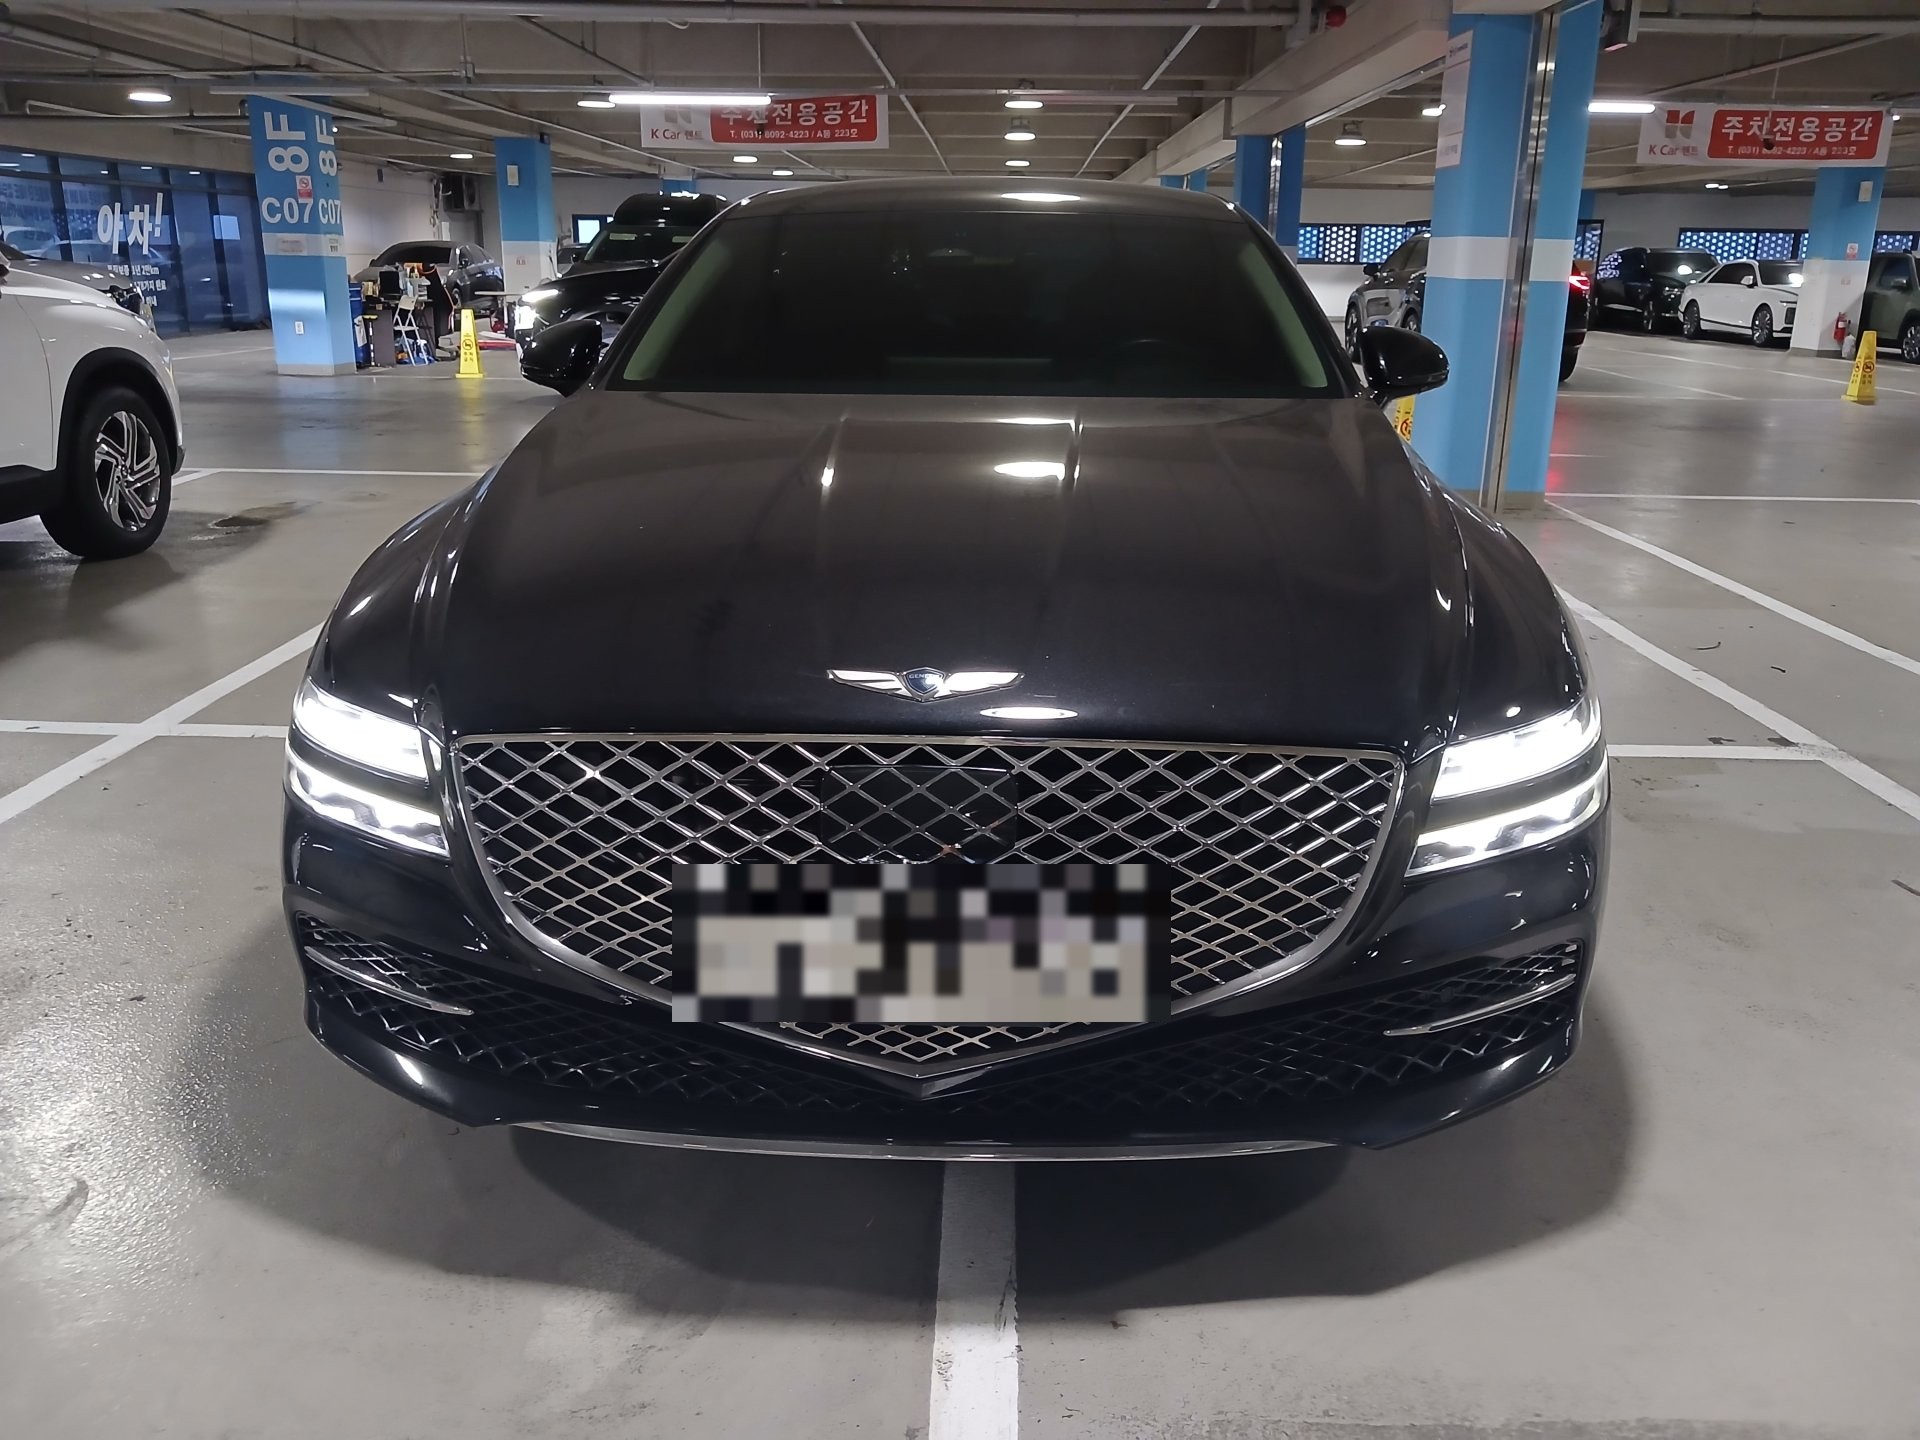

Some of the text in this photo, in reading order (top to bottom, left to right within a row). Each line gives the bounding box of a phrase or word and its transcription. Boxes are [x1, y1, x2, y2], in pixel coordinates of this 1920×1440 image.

[264, 111, 310, 173] 8F
[651, 128, 660, 139] K
[662, 128, 680, 139] Car
[1721, 116, 1873, 142] 주차전용공간
[315, 114, 338, 176] 8F
[1648, 144, 1658, 155] K
[1660, 144, 1679, 155] Car
[97, 192, 164, 255] 아차!
[261, 197, 314, 224] C07
[318, 198, 341, 225] C07
